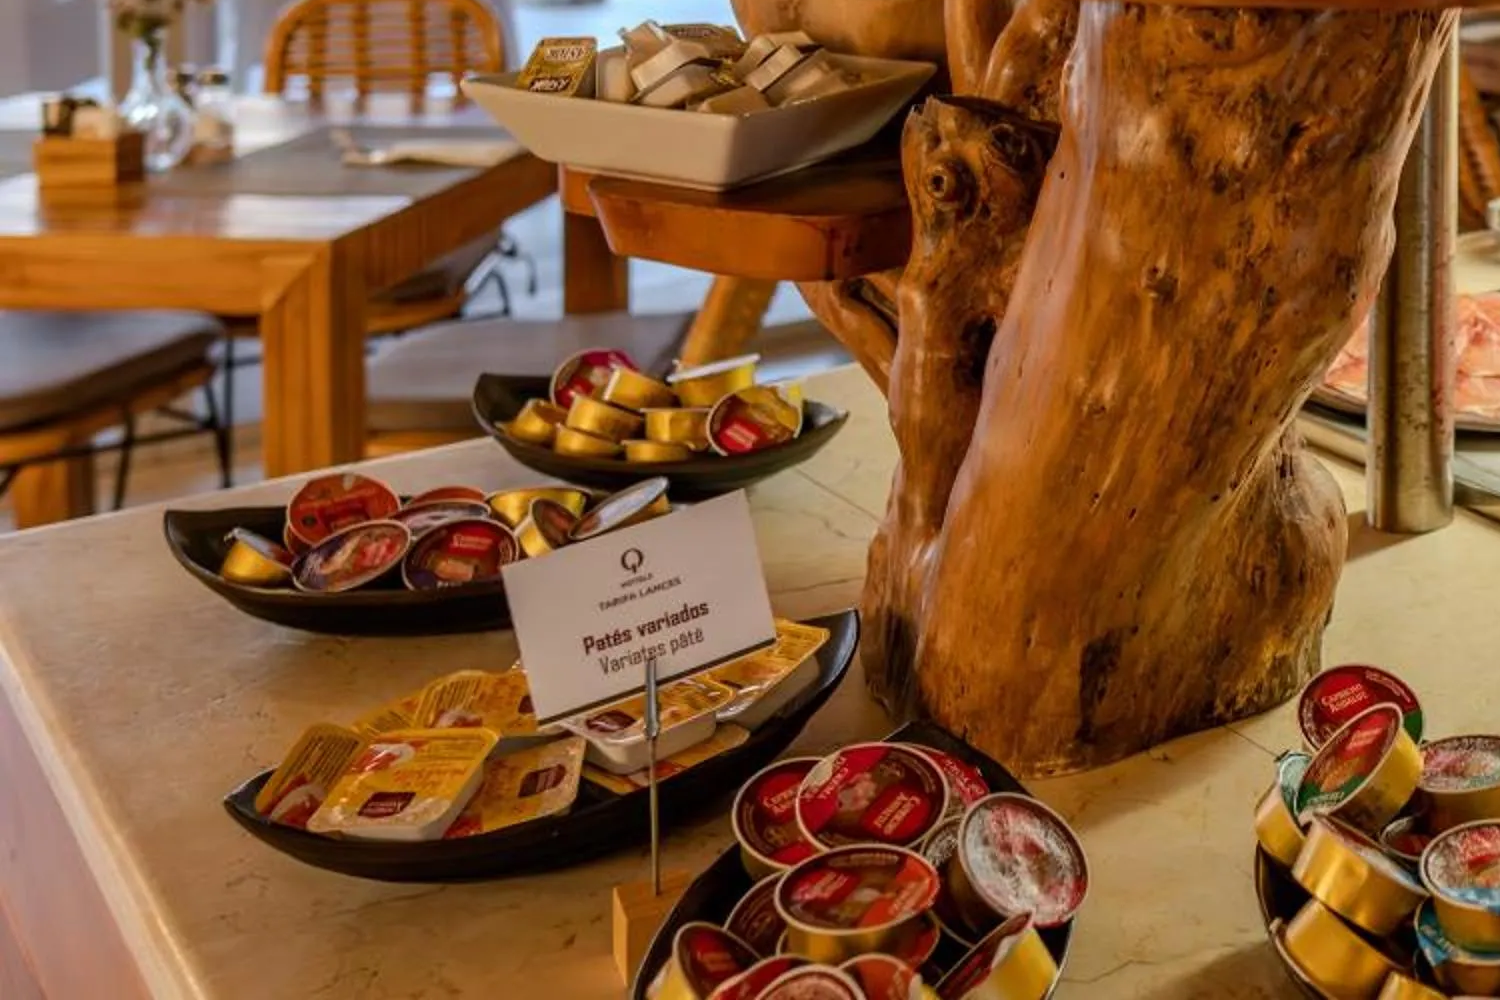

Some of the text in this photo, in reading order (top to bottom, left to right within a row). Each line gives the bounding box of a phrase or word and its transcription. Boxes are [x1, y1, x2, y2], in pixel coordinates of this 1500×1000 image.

[582, 600, 710, 655] Patés variados
[598, 627, 705, 676] Variates pâté
